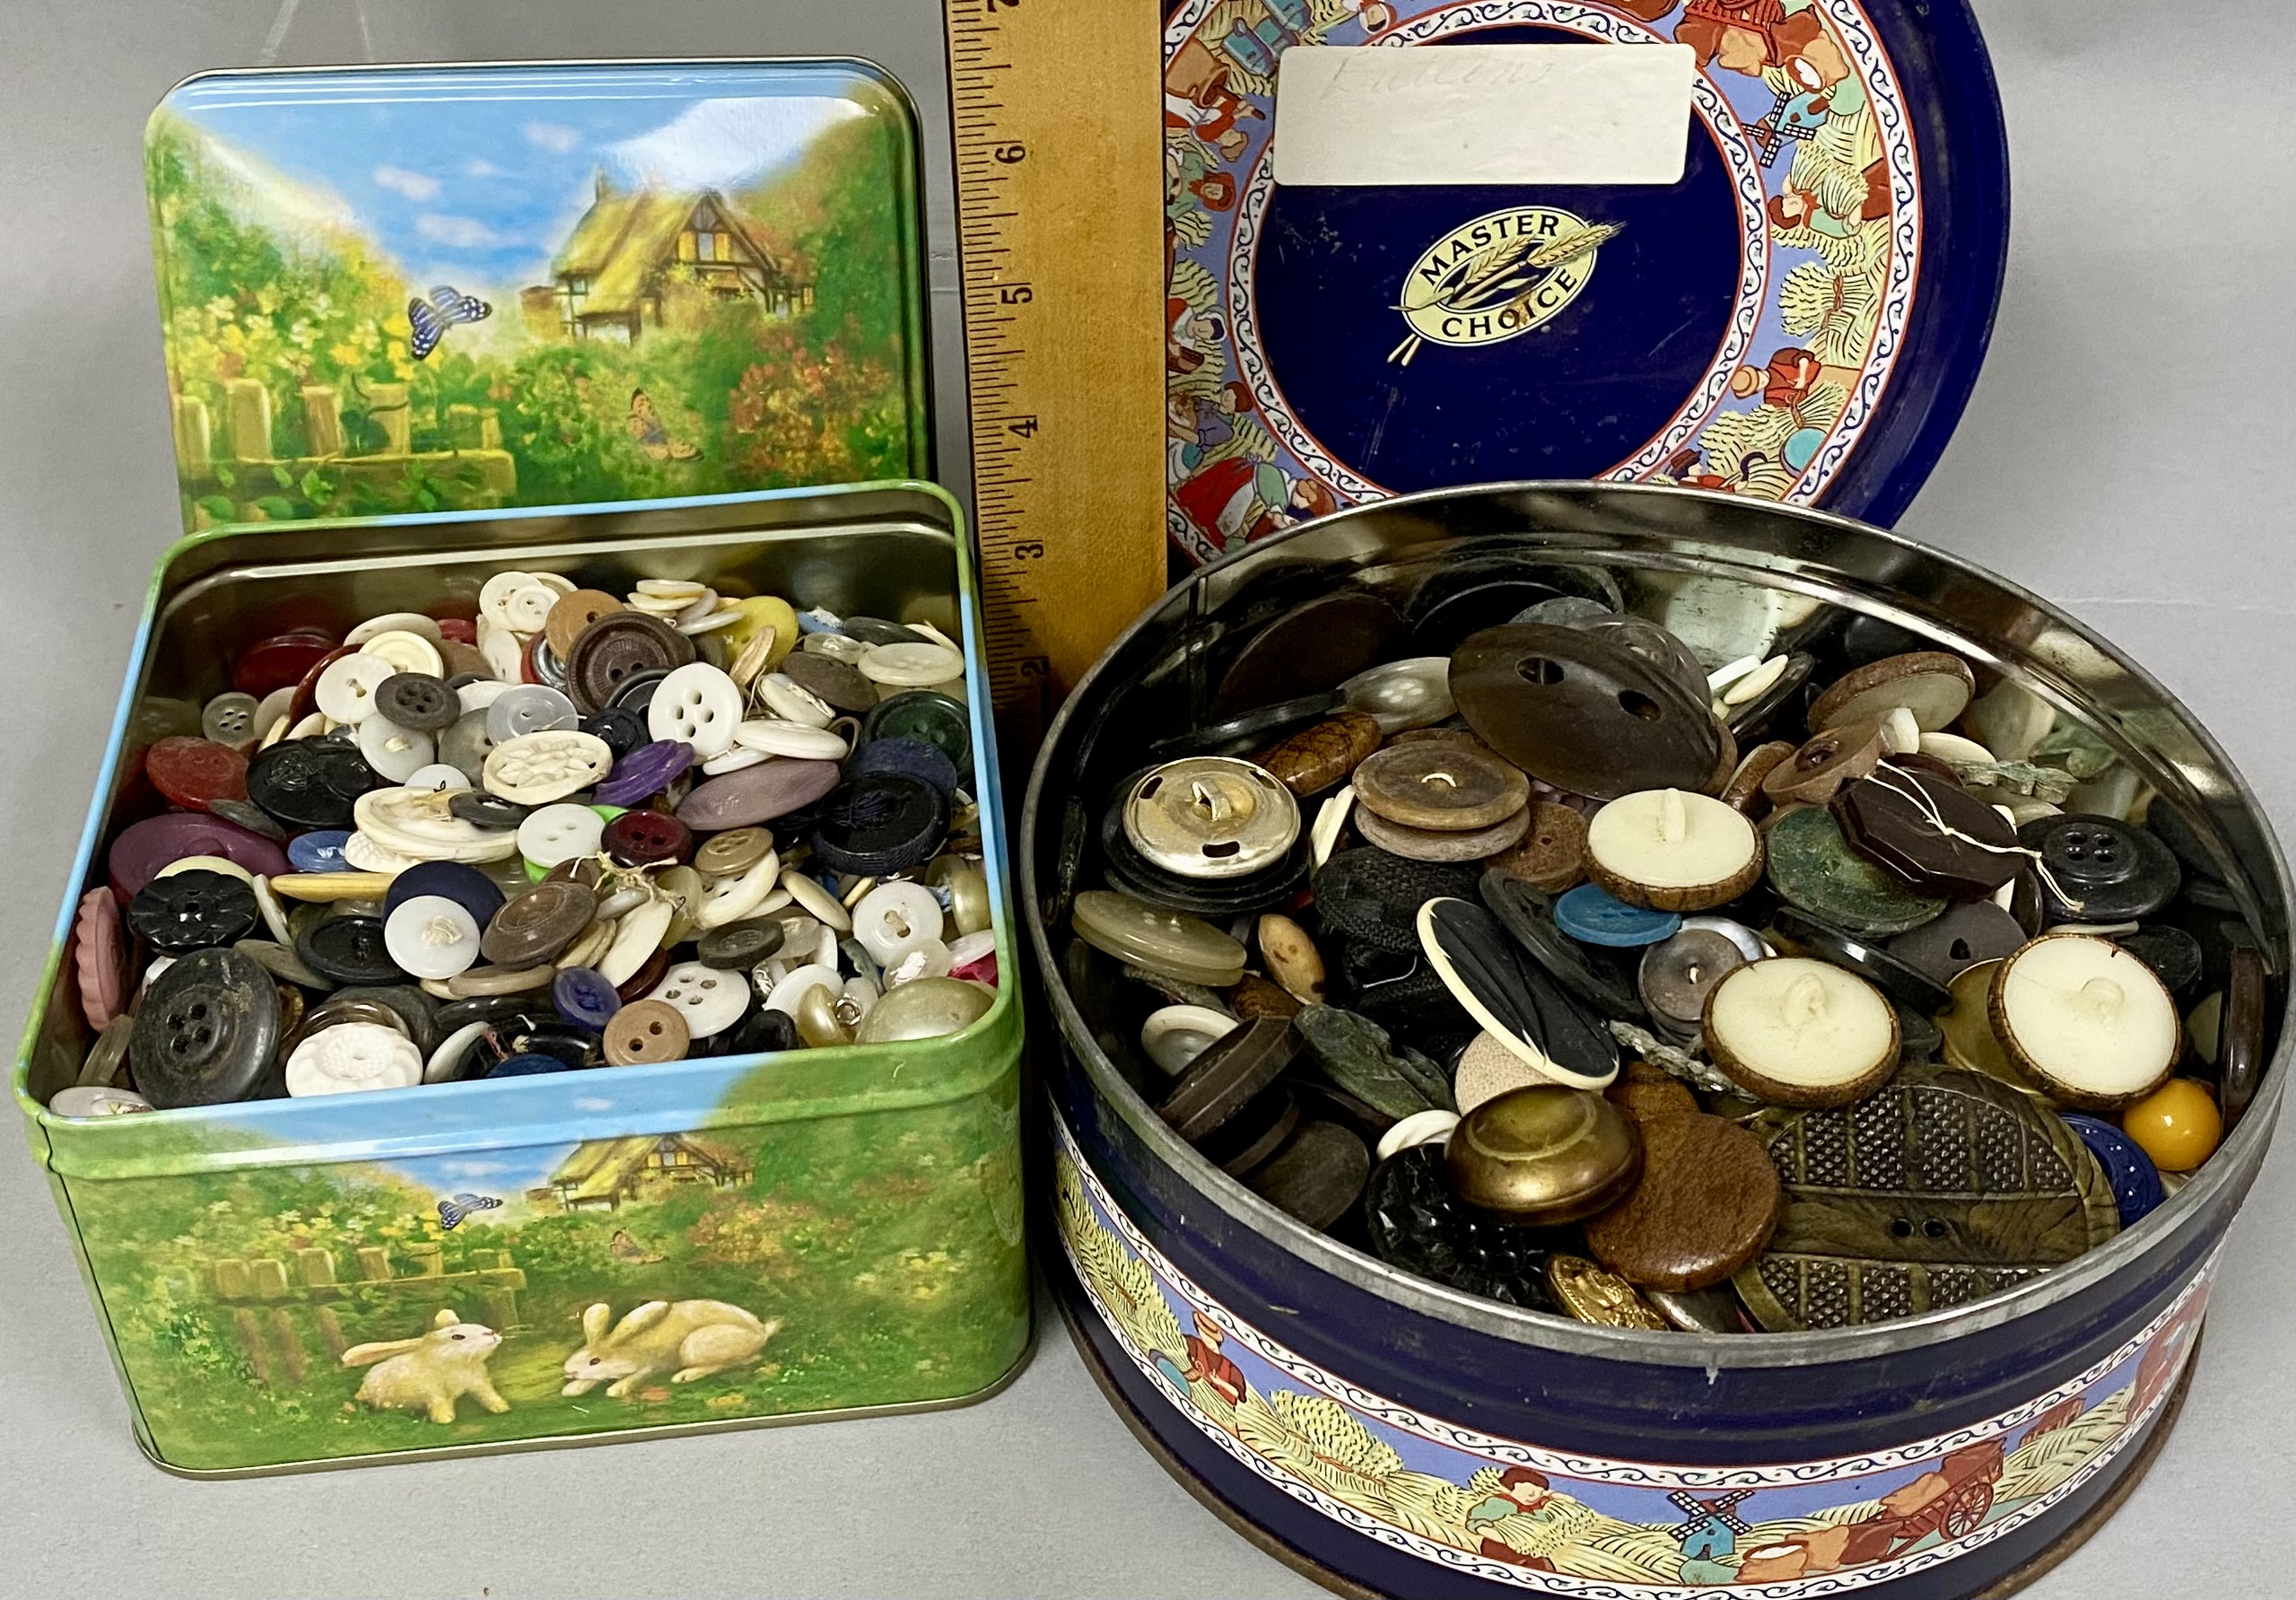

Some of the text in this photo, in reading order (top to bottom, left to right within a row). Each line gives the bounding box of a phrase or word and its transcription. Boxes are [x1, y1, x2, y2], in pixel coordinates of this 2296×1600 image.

[994, 145, 1026, 164] 6
[1419, 214, 1559, 286] MASTER
[1000, 287, 1033, 304] 5
[1441, 268, 1577, 337] CHOICE
[1008, 418, 1039, 438] 4
[1014, 544, 1043, 560] 3
[1020, 659, 1050, 676] 2
